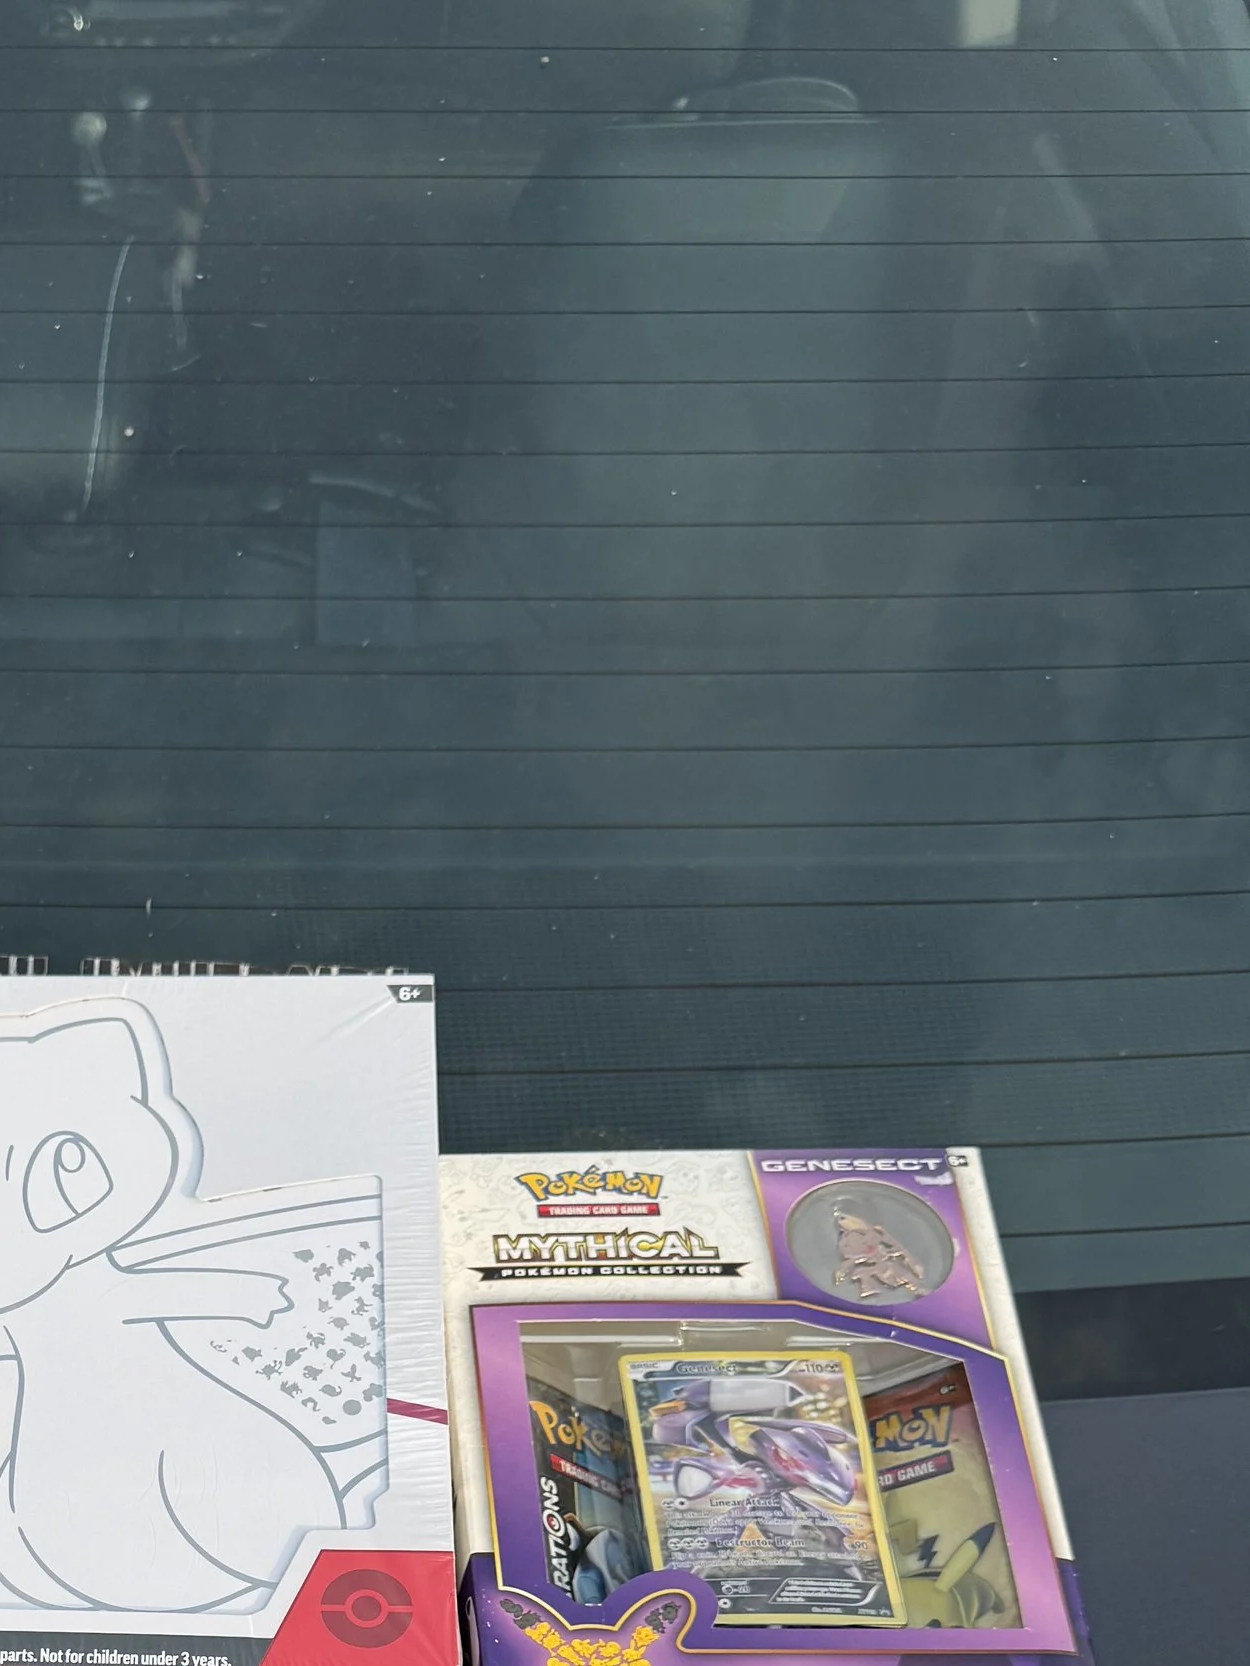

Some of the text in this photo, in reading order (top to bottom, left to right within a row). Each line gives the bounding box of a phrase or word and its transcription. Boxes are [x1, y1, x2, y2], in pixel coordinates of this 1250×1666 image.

[399, 986, 421, 1001] 6+
[760, 1157, 943, 1173] GENESECT
[515, 1164, 664, 1201] Pokémon
[549, 1205, 649, 1216] TRADING CARD GAME
[493, 1227, 720, 1263] MYTHICAL
[599, 1265, 722, 1276] COLLECTION
[0, 1649, 38, 1666] parts.
[40, 1648, 63, 1664] Not
[65, 1648, 83, 1664] for
[86, 1649, 139, 1666] children
[141, 1650, 179, 1666] under
[180, 1651, 190, 1666] 3
